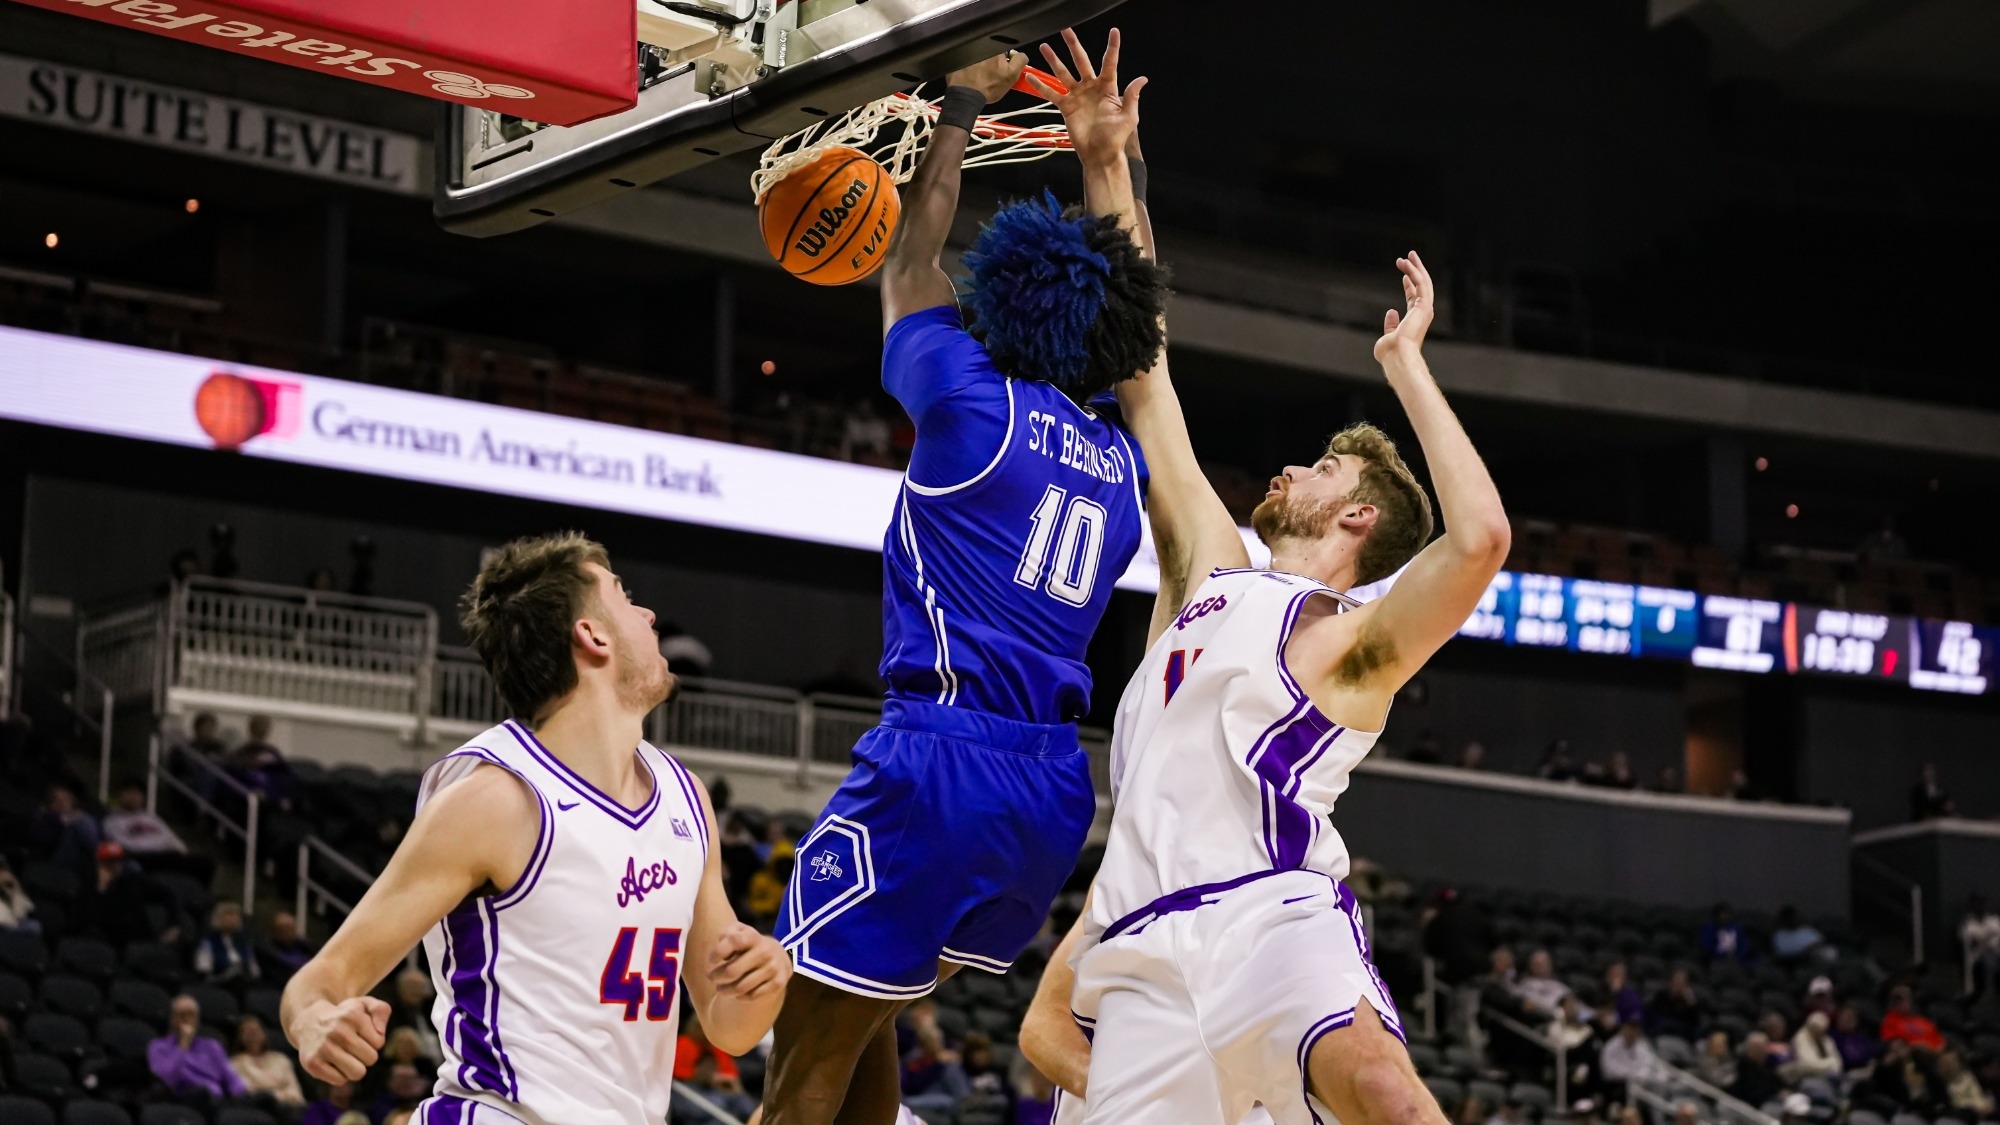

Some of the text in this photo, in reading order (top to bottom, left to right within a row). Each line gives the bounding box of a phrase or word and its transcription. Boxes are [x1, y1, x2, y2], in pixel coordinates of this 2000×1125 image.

[28, 65, 402, 187] SUITE LEVEL
[794, 178, 869, 257] Wilson
[312, 401, 725, 499] German American Bank
[1028, 410, 1056, 459] ST.
[1013, 483, 1108, 609] 10
[617, 856, 677, 908] Aces
[600, 927, 682, 1021] 45
